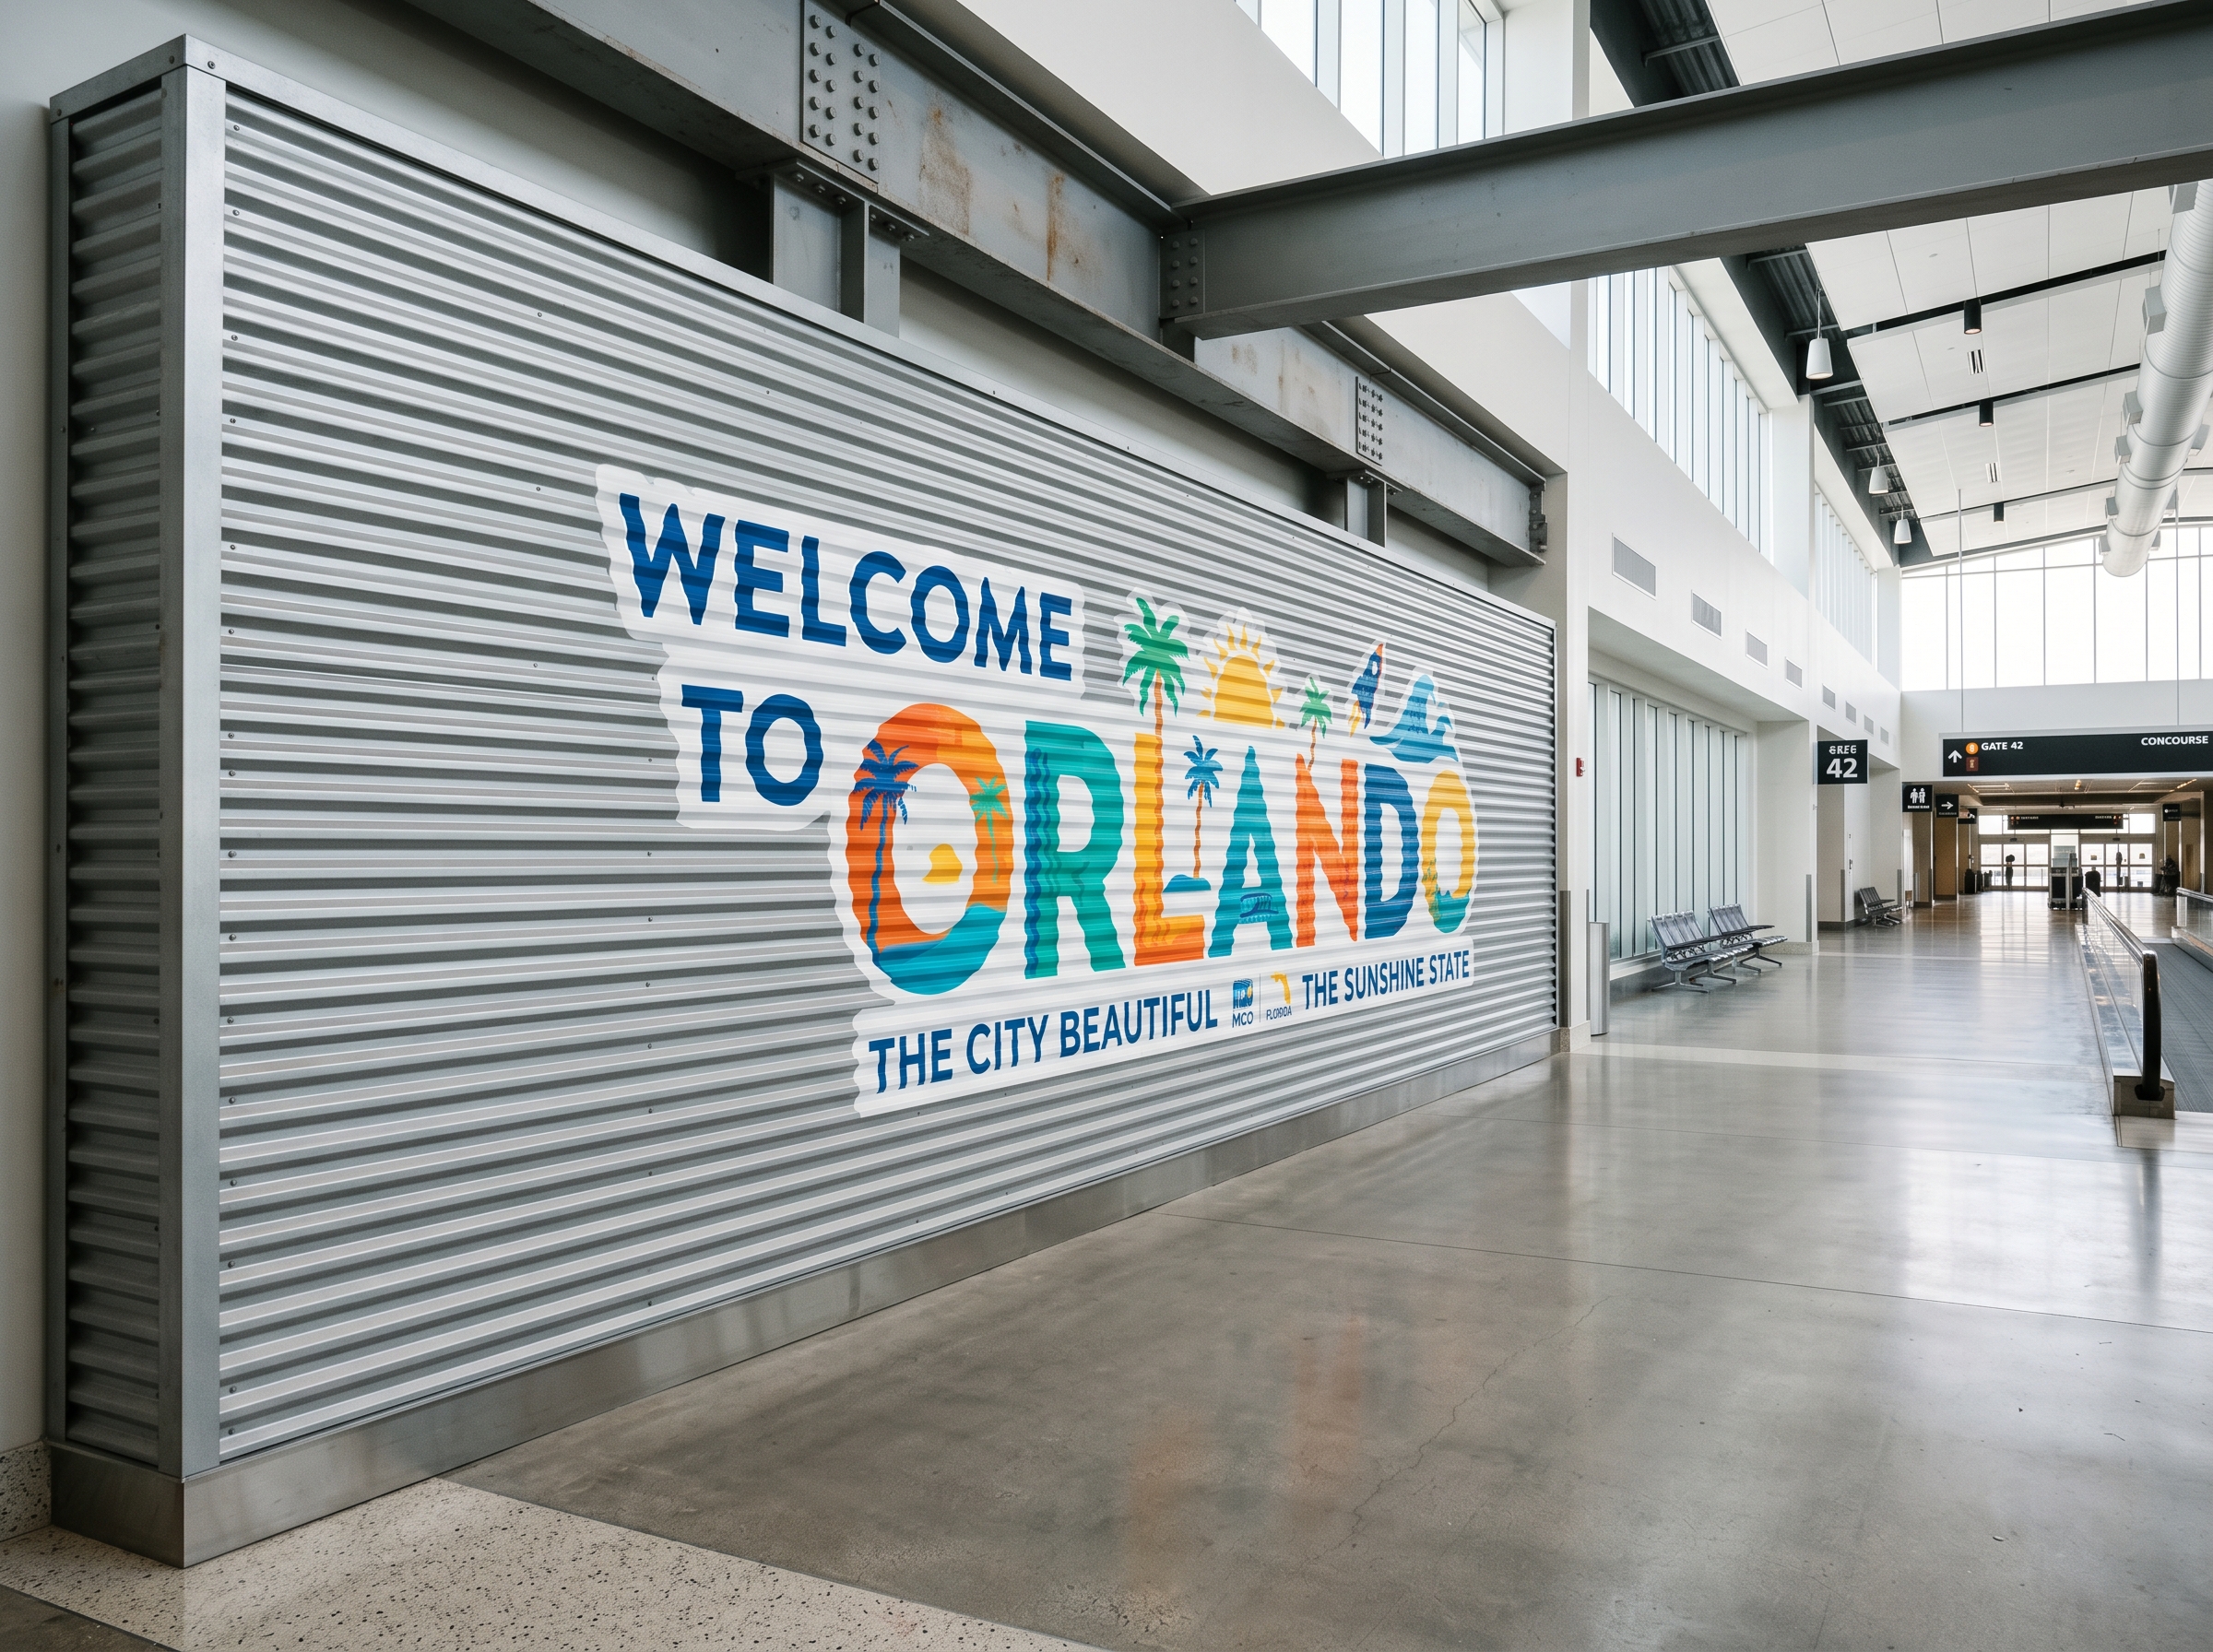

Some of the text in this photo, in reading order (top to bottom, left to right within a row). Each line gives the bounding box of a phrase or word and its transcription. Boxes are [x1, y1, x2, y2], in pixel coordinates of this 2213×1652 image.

[619, 492, 1072, 681] WELCOME
[681, 684, 823, 806] TO
[1826, 758, 1858, 778] 42
[1981, 741, 2024, 750] GATE 42
[2141, 736, 2209, 746] CONCOURSE
[846, 703, 1479, 994] ORLANDO
[1302, 950, 1470, 1010] THE SUNSHINE STATE
[869, 990, 1218, 1094] THE CITY BEAUTIFUL
[1232, 1010, 1254, 1028] MCO
